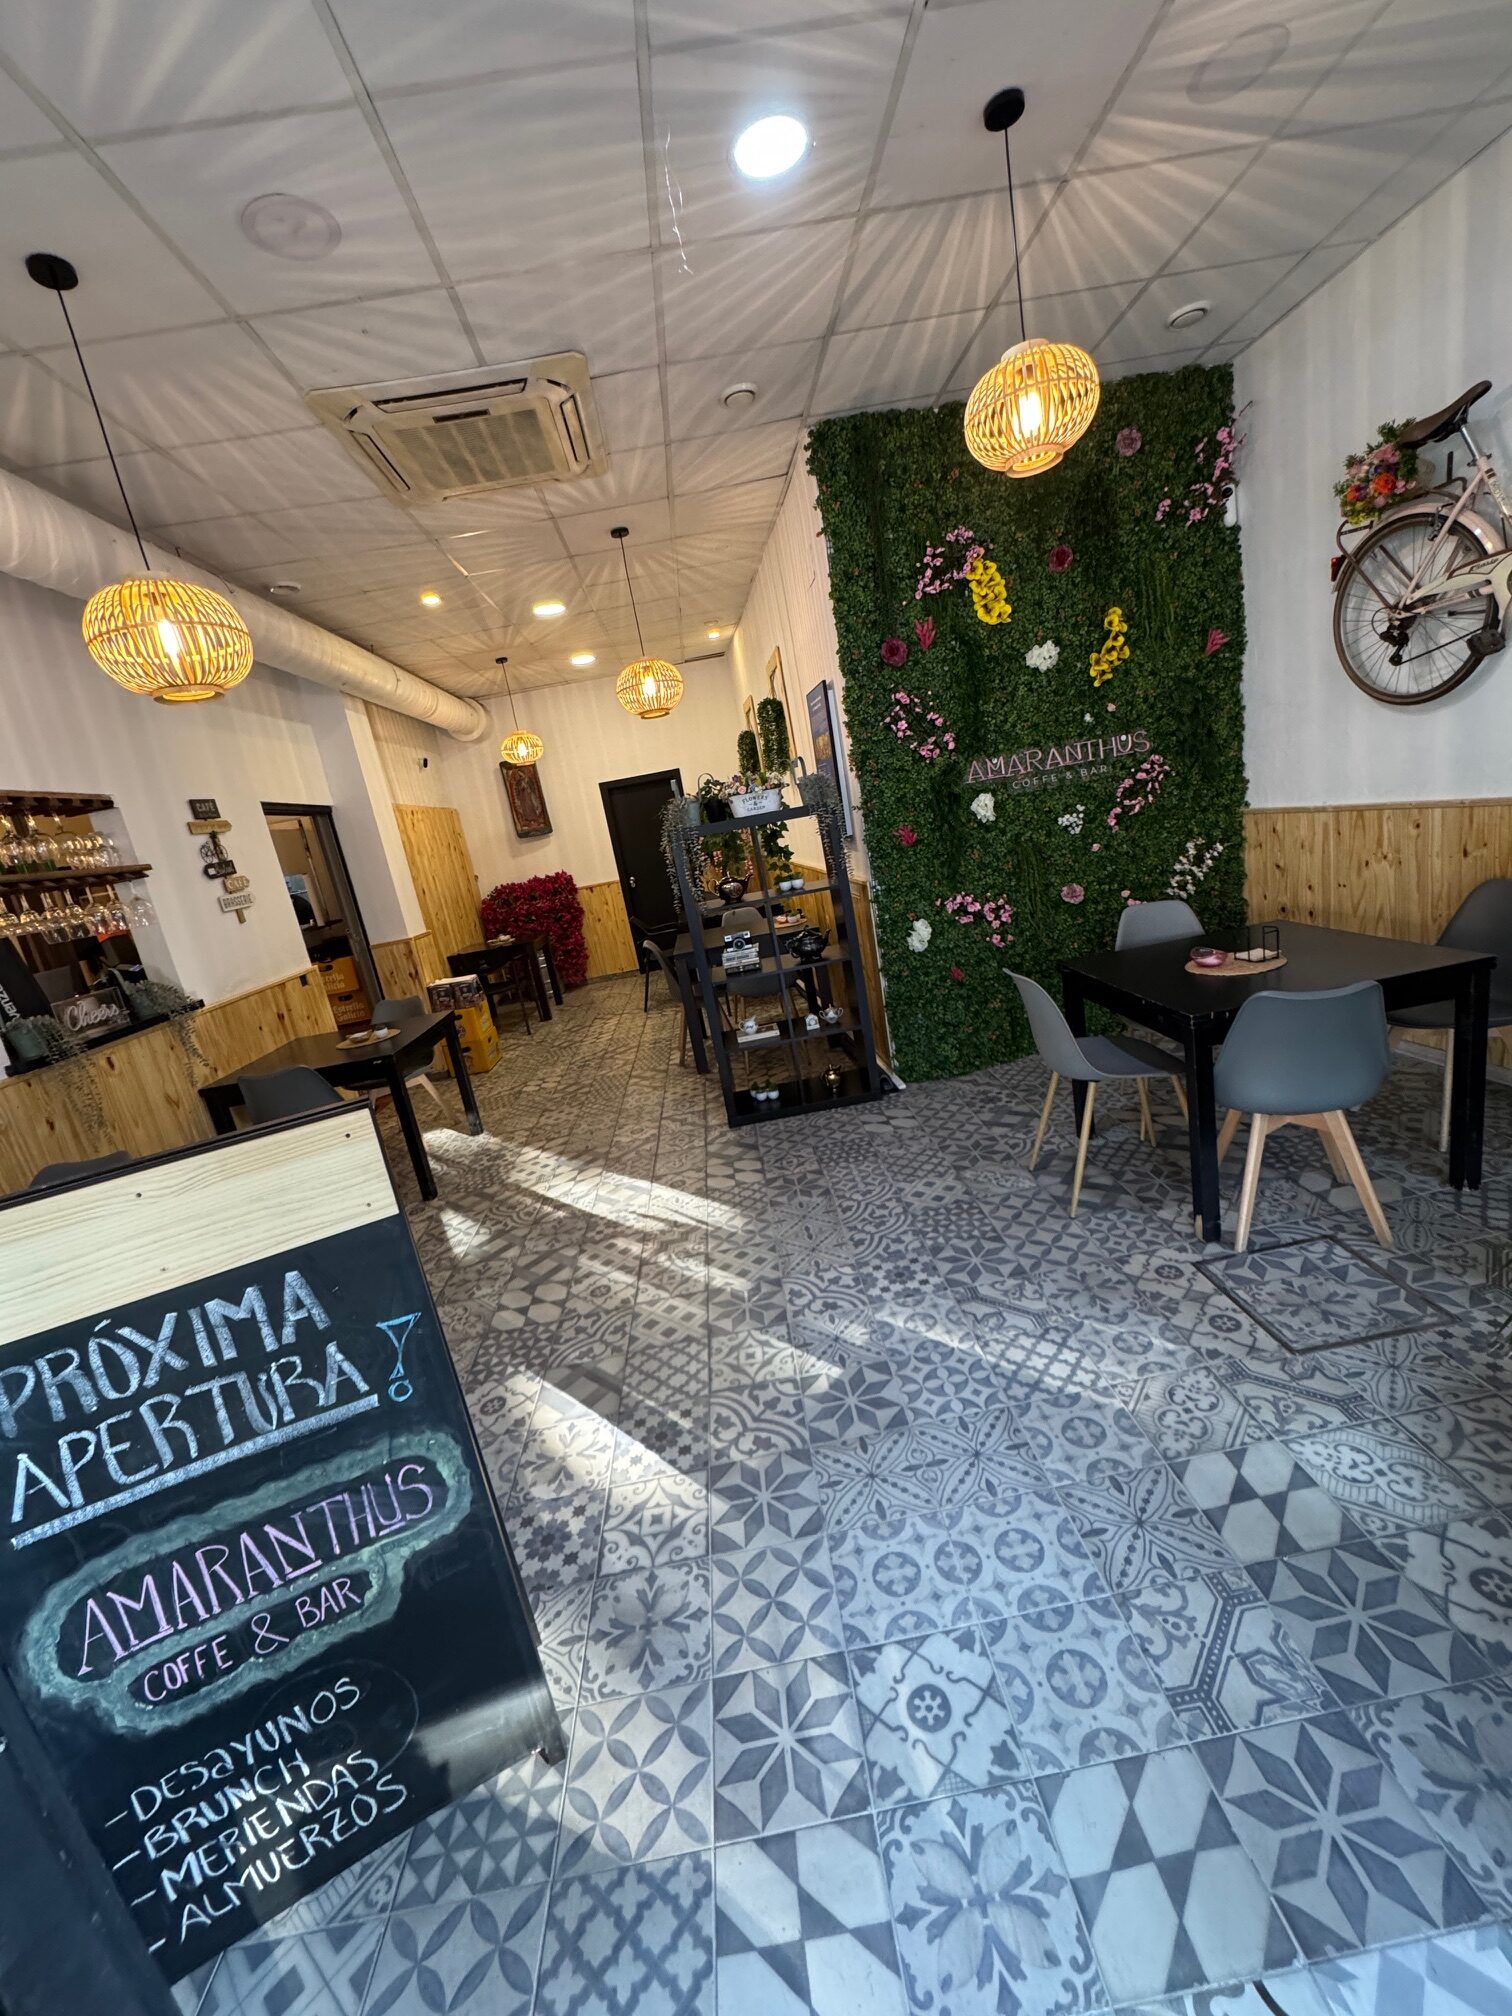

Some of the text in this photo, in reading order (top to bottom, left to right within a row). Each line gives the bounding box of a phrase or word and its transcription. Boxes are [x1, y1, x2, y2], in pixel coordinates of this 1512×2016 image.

[966, 730, 1150, 784] AMARANTHUS
[1012, 765, 1108, 789] COFFE & BAR
[67, 1001, 120, 1031] Cheers
[0, 1270, 332, 1438] PRÓXIMA
[11, 1340, 370, 1524] APERTURA
[78, 1464, 434, 1677] AMARANTHUS
[144, 1577, 362, 1701] COFFE & BAR
